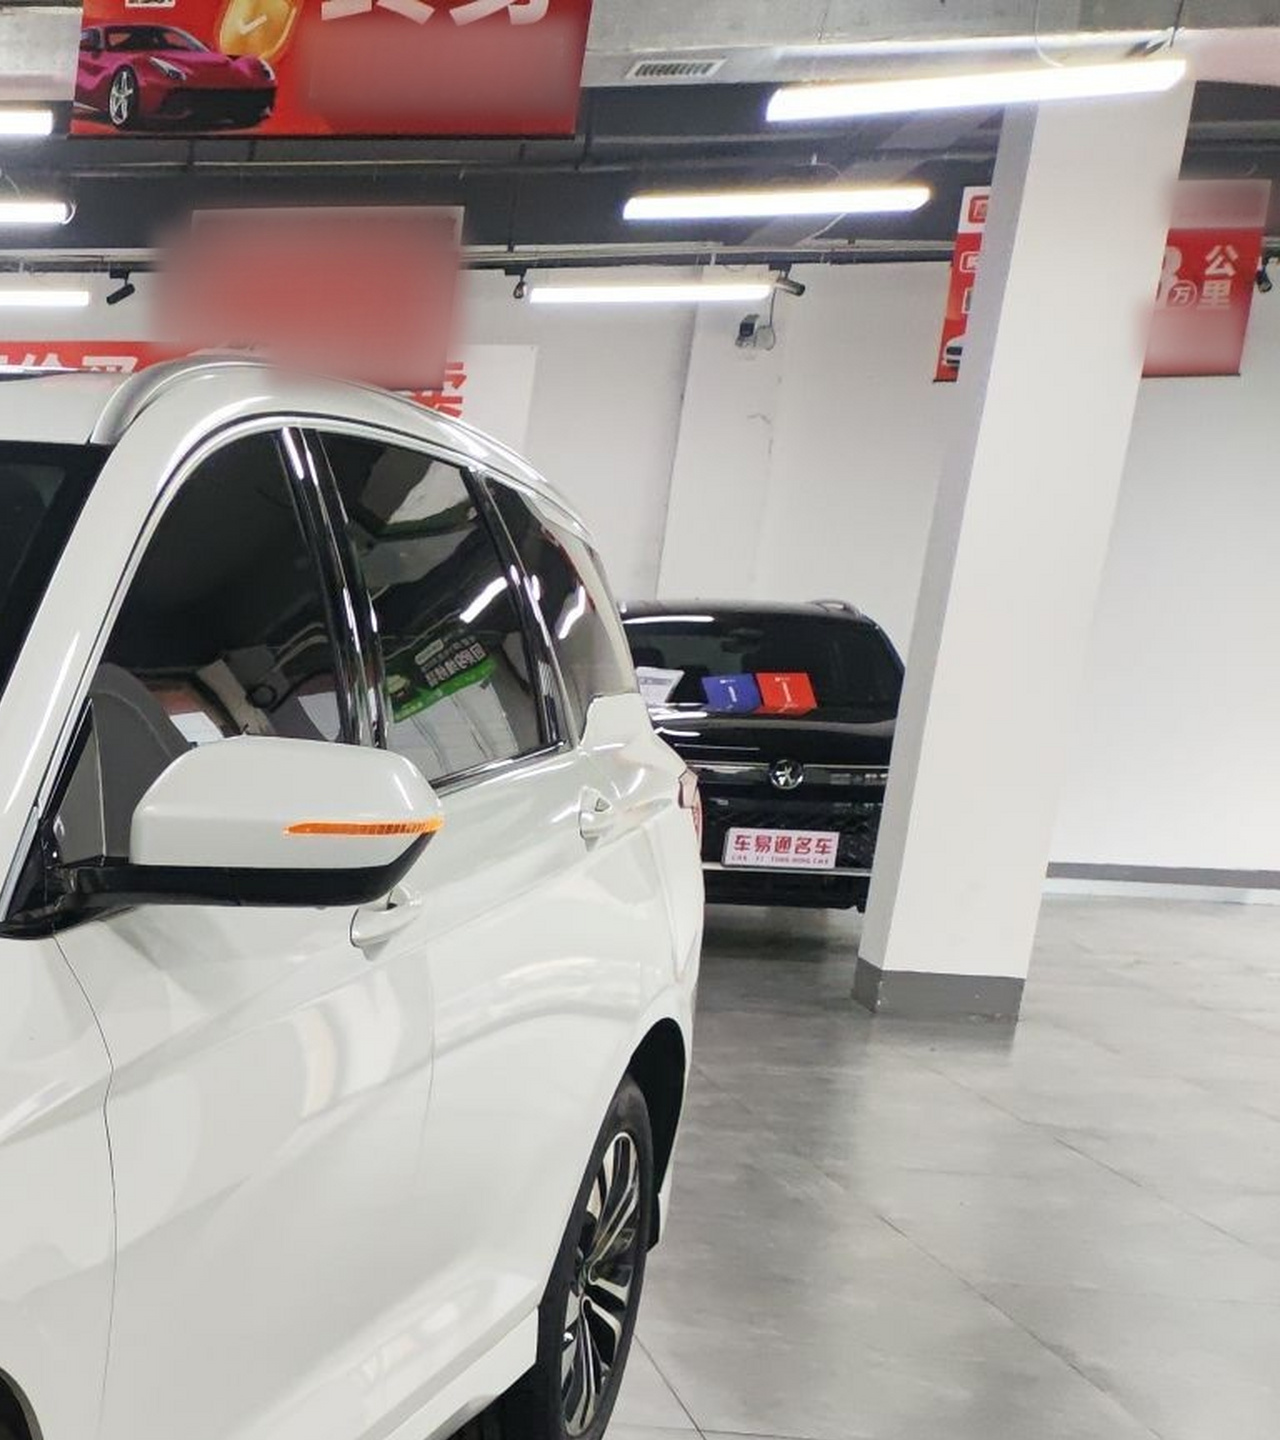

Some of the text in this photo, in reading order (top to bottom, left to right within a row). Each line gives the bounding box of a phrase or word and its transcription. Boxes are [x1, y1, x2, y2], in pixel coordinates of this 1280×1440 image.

[733, 834, 833, 855] 车易通名车
